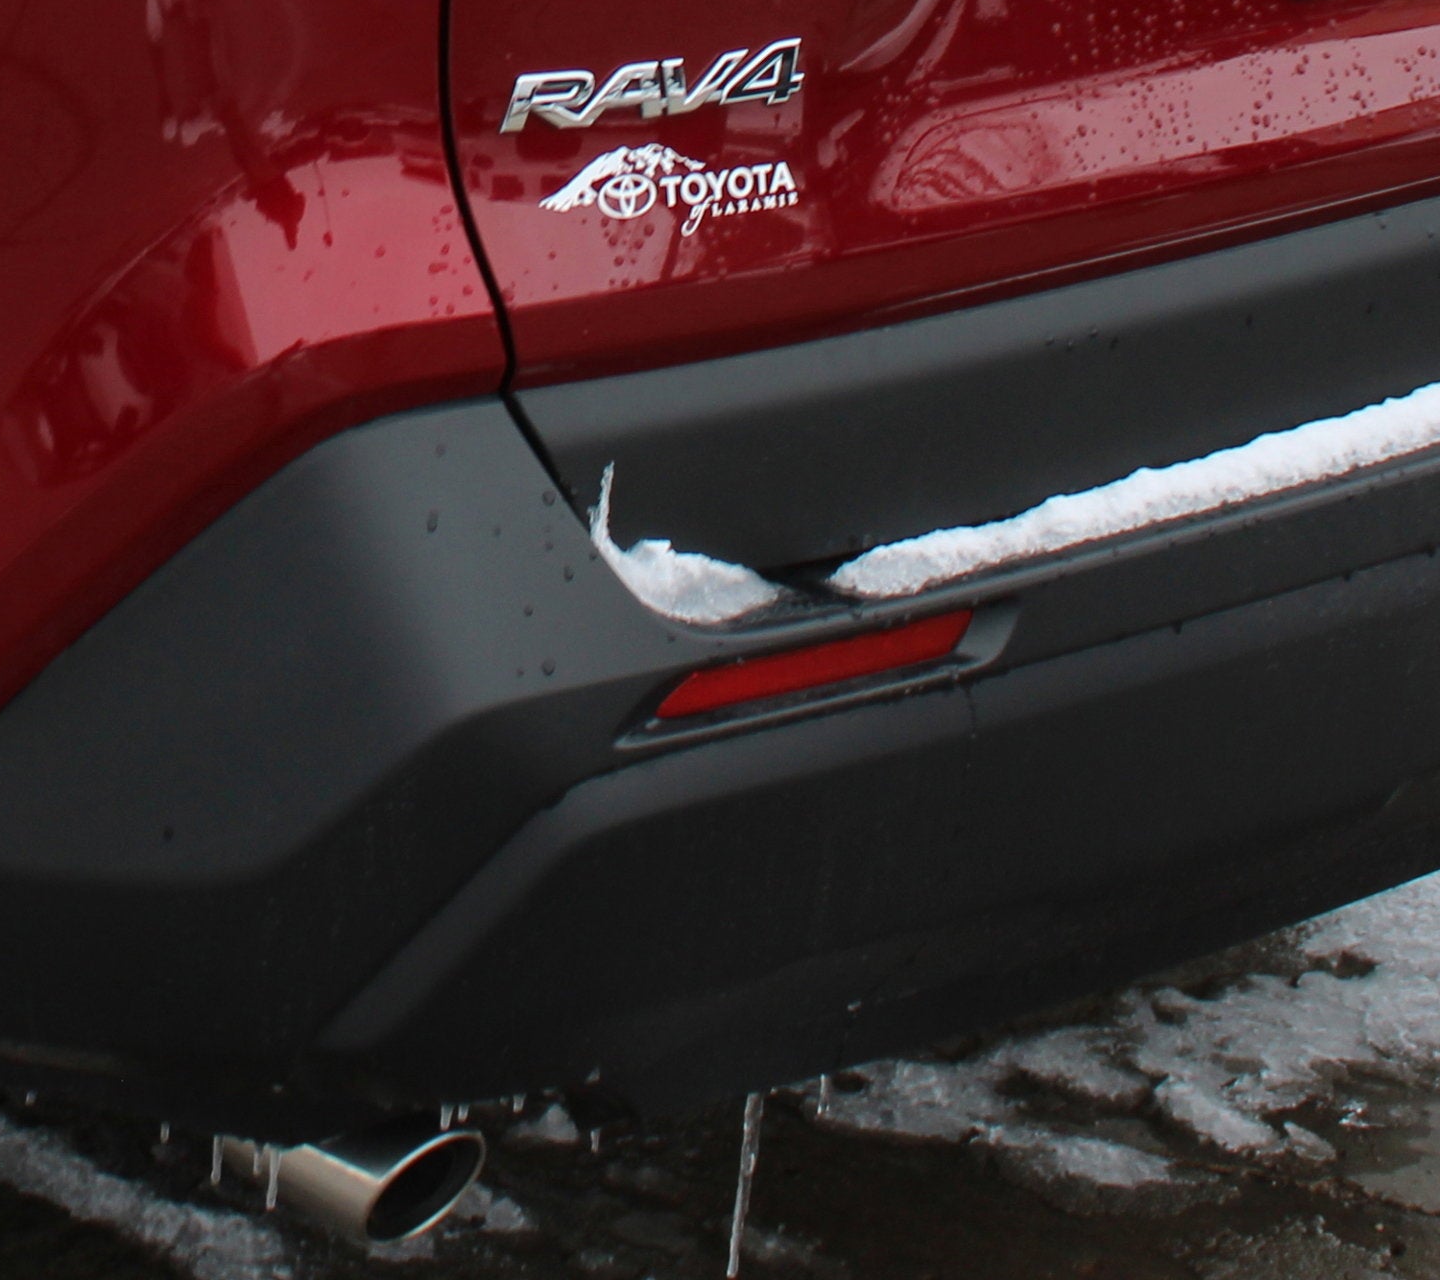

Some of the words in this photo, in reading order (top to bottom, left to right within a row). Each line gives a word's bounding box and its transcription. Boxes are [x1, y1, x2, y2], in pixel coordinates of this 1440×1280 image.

[499, 37, 806, 134] RAV4
[659, 160, 797, 208] TOYOTA
[710, 190, 800, 218] LARAMIE
